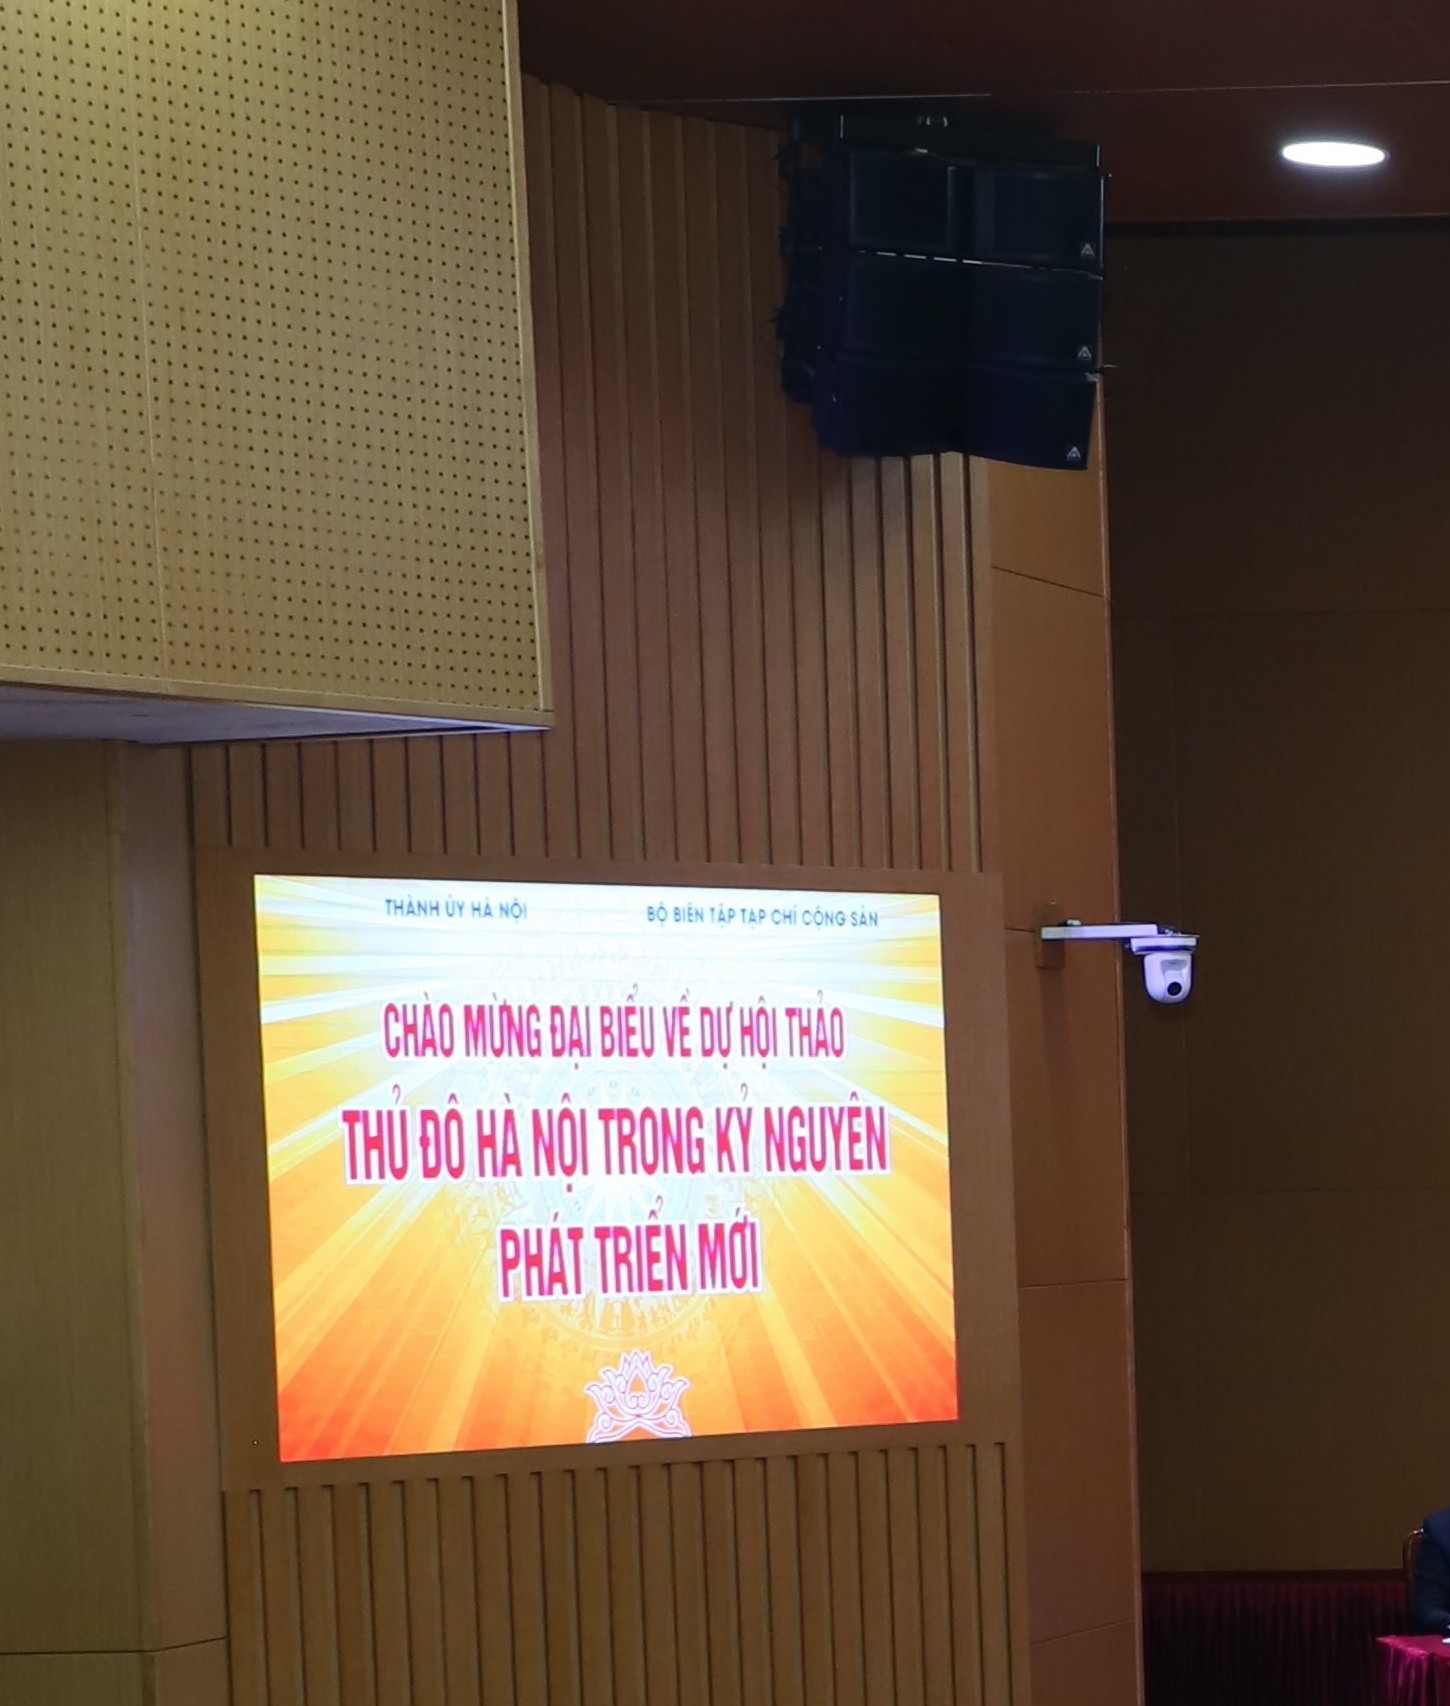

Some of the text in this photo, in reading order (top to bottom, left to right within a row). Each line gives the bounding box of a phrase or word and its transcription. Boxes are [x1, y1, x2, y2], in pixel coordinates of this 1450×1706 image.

[385, 897, 440, 919] THÀNH
[471, 898, 493, 920] HÀ
[499, 897, 527, 922] NỘI
[647, 903, 878, 930] BỘ BIÊN TẬP TẠP CHÍ CỘNG SẢN
[385, 984, 844, 1070] CHÀO MỪNG ĐẠI BIỂU VỀ DỰ HỘI THẢO
[342, 1082, 887, 1192] THỦ ĐÔ HÀ NỘI TRONG KỶ NGUYÊN
[500, 1195, 759, 1299] PHÁT TRIỂN MỚI
